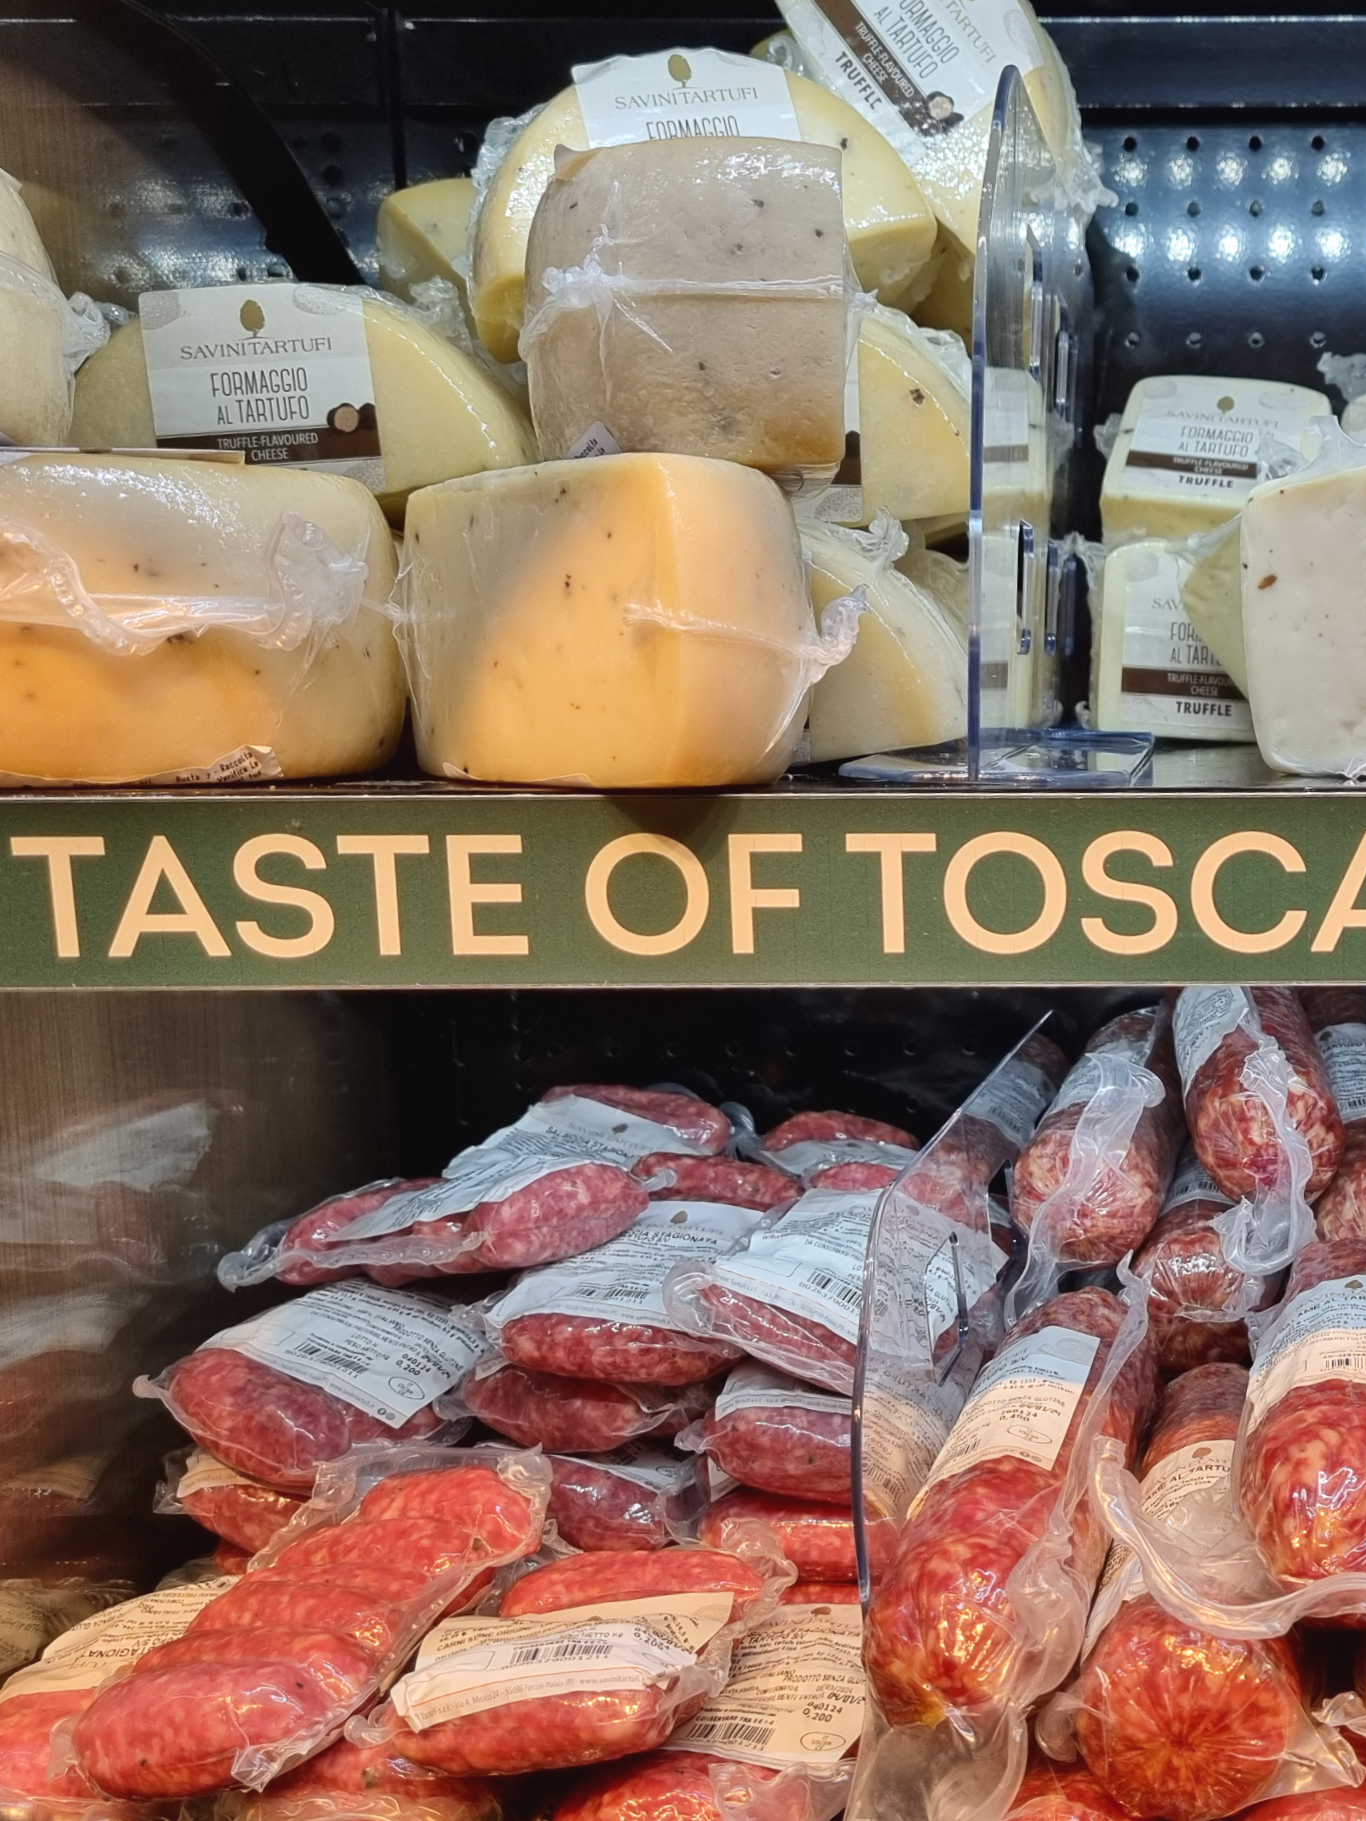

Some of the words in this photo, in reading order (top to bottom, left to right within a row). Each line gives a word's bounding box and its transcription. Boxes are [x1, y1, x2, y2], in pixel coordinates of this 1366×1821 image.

[899, 0, 960, 64] ORMAGGIO
[874, 6, 890, 26] AL
[886, 19, 938, 79] TARTUFO
[854, 21, 914, 97] TRUFFLE-FLAVOURED
[863, 53, 889, 84] CHEESE
[835, 51, 882, 110] TRUFFLE
[646, 115, 740, 140] FORMAGGIO
[211, 367, 308, 397] FORMAGGIO
[217, 405, 233, 425] AL
[235, 395, 310, 424] TARTUFO
[217, 432, 318, 449] TRUFFLE-FLAVOURED
[1181, 426, 1254, 444] FORMAGGIO
[251, 448, 289, 461] CHEESE
[1194, 442, 1249, 458] TARTUFO
[1194, 466, 1223, 475] CHEESE
[1179, 475, 1234, 488] TRUFFLE
[1170, 648, 1182, 663] AL
[1191, 686, 1219, 696] CHEESE
[1176, 701, 1232, 716] TRUFFLE
[11, 834, 528, 958] TASTE
[586, 834, 802, 955] OF
[654, 1231, 718, 1245] STAGIONATA
[1189, 1464, 1230, 1473] TARTU
[581, 1631, 609, 1639] NETTO
[437, 1641, 466, 1651] CARNI
[579, 1675, 642, 1686] www.savinitartufi.
[760, 1670, 796, 1679] ITALIANO
[783, 1674, 821, 1683] PRODOTTO
[822, 1674, 844, 1683] SENZA
[847, 1676, 866, 1685] GLUT
